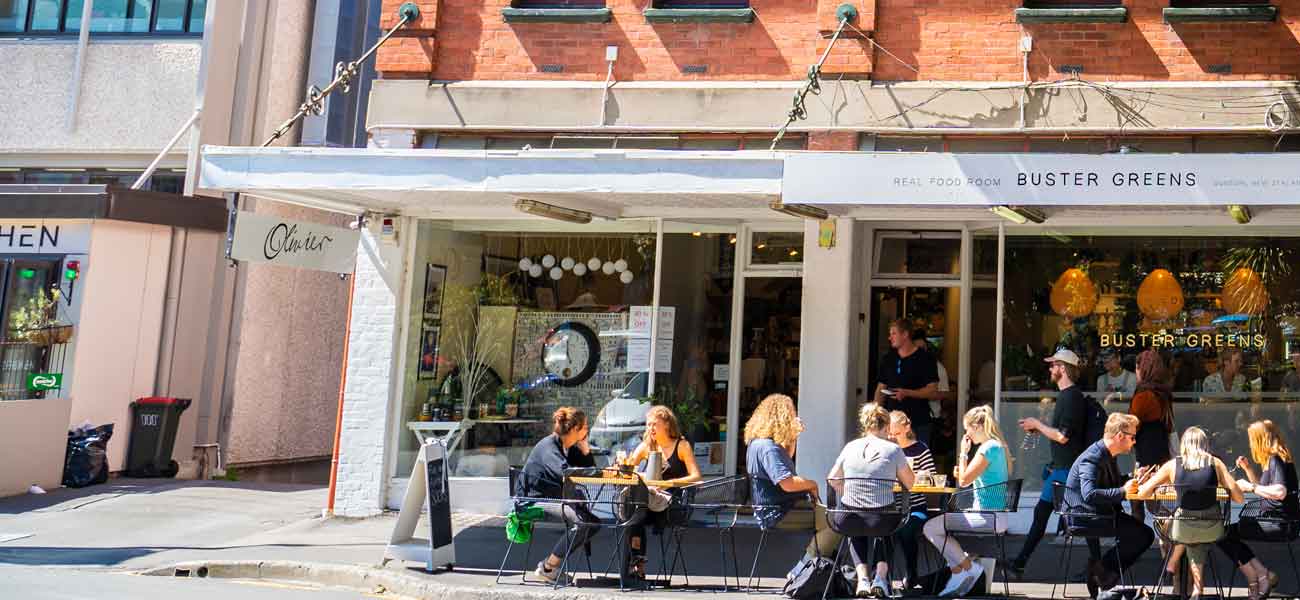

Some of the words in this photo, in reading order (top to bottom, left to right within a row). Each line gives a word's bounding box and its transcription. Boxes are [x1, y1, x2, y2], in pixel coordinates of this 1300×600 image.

[894, 177, 922, 187] REAL
[929, 177, 961, 187] FOOD
[967, 177, 1001, 187] ROOM
[1017, 172, 1099, 187] BUSTER
[1112, 172, 1197, 187] GREENS
[263, 223, 334, 260] Olivier
[1099, 334, 1175, 348] BUSTER
[1186, 334, 1265, 348] GREENS
